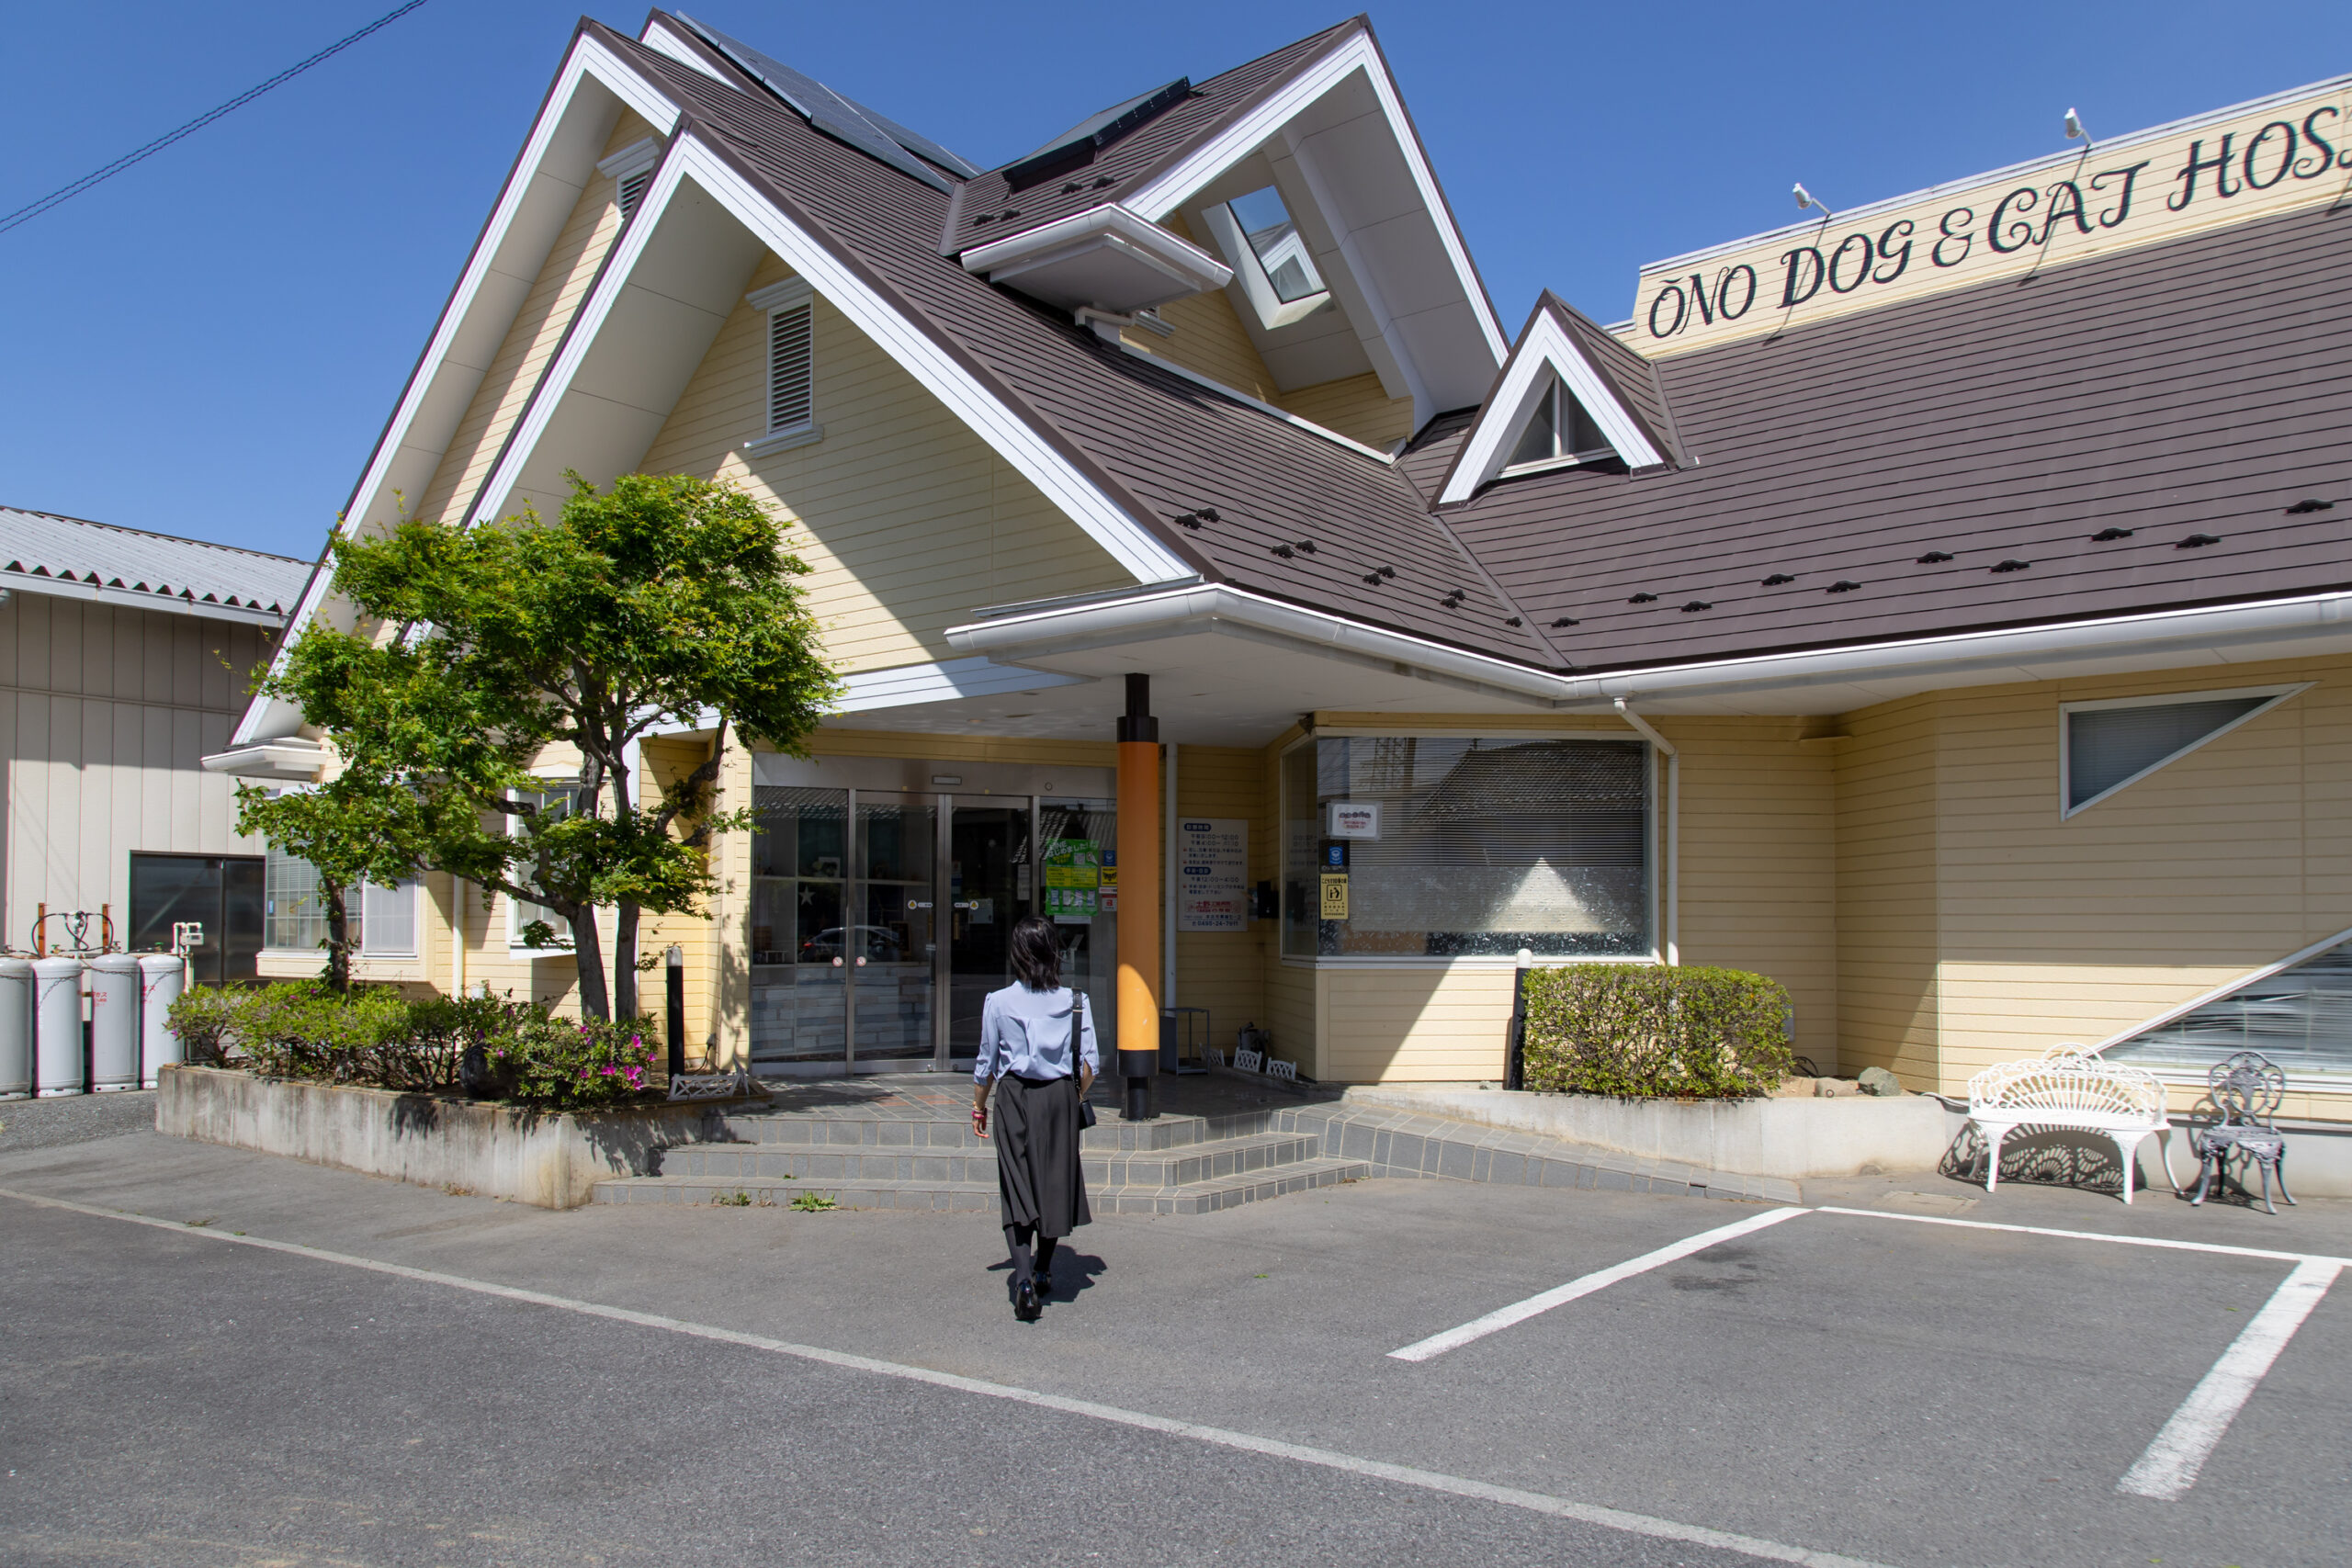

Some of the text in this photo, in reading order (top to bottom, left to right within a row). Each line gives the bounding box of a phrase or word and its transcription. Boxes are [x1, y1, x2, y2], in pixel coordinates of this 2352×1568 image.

[1777, 220, 1916, 309] DOG
[1931, 208, 1974, 267] &
[1987, 161, 2150, 254] CAT
[2167, 106, 2352, 211] HOS
